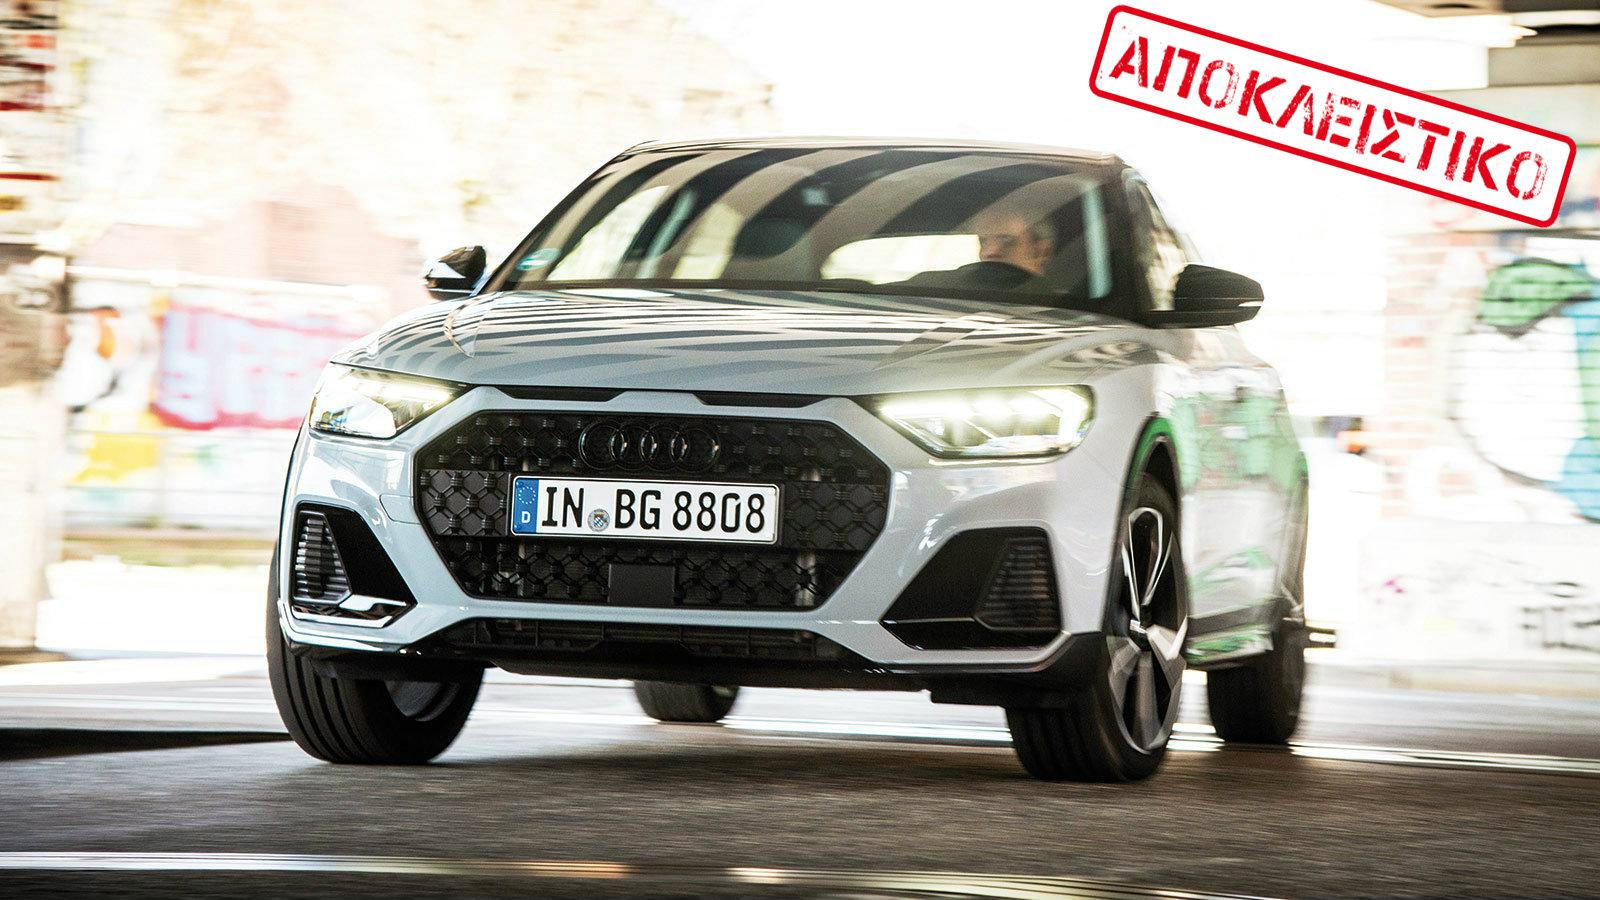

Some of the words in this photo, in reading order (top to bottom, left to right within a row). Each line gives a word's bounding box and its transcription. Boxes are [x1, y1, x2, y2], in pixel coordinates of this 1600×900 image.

[521, 510, 531, 524] D
[541, 486, 585, 528] IN
[614, 488, 662, 531] BG
[672, 490, 765, 534] 8808
